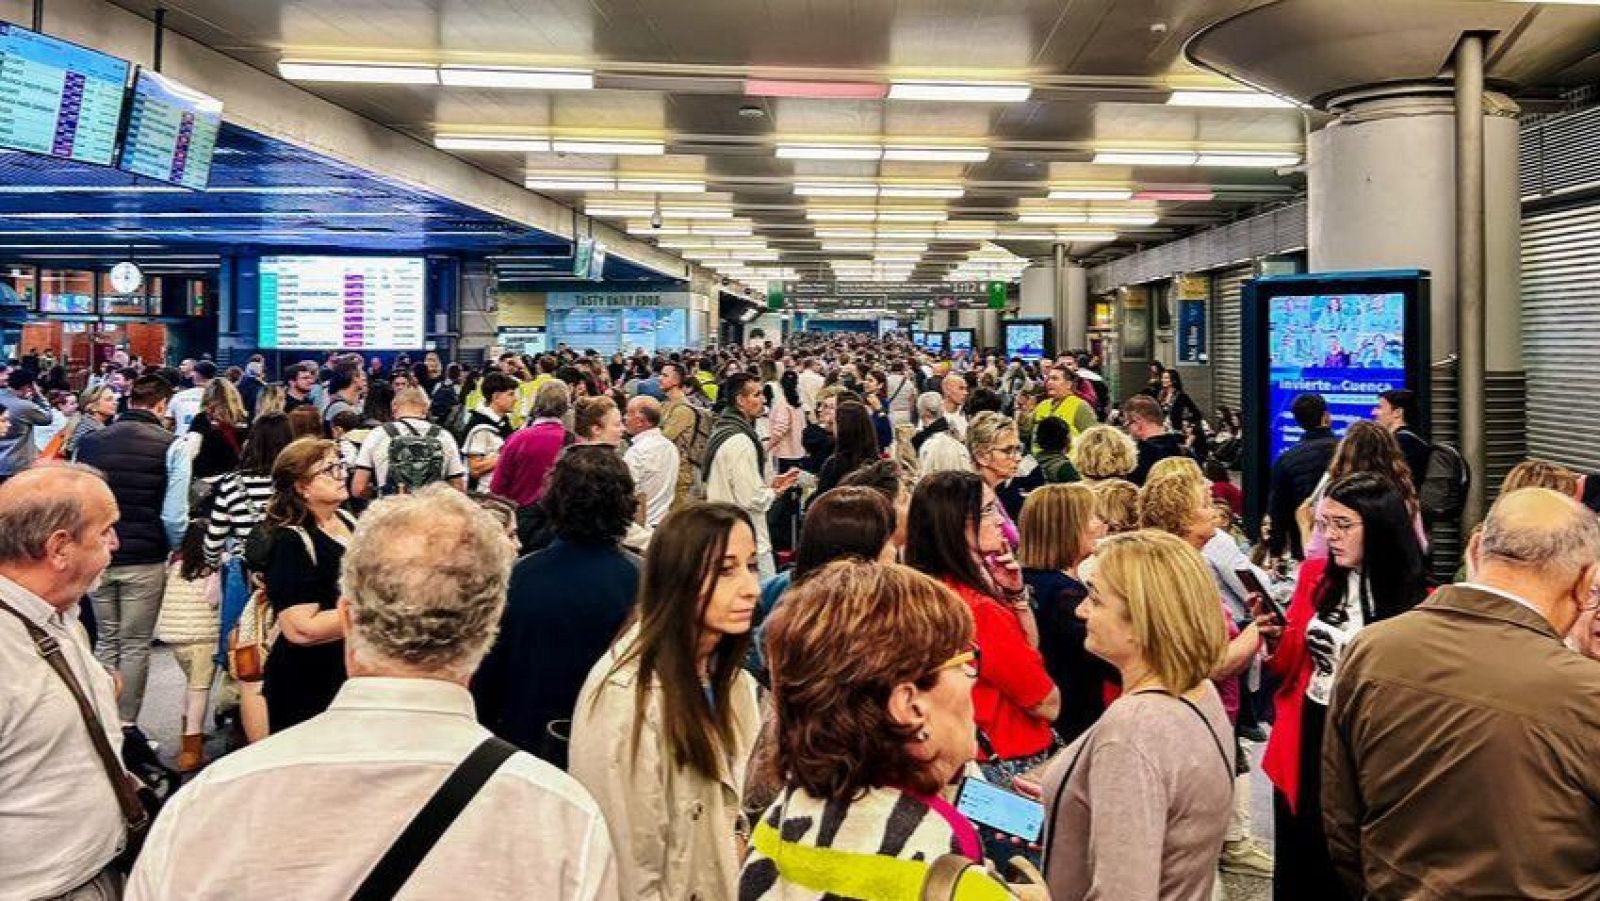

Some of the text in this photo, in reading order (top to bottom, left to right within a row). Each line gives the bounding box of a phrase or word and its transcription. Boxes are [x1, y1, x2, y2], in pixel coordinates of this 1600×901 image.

[575, 295, 660, 306] TASTY DAILY FOOD
[1280, 380, 1331, 391] Invierte
[1342, 380, 1392, 392] Cuenca
